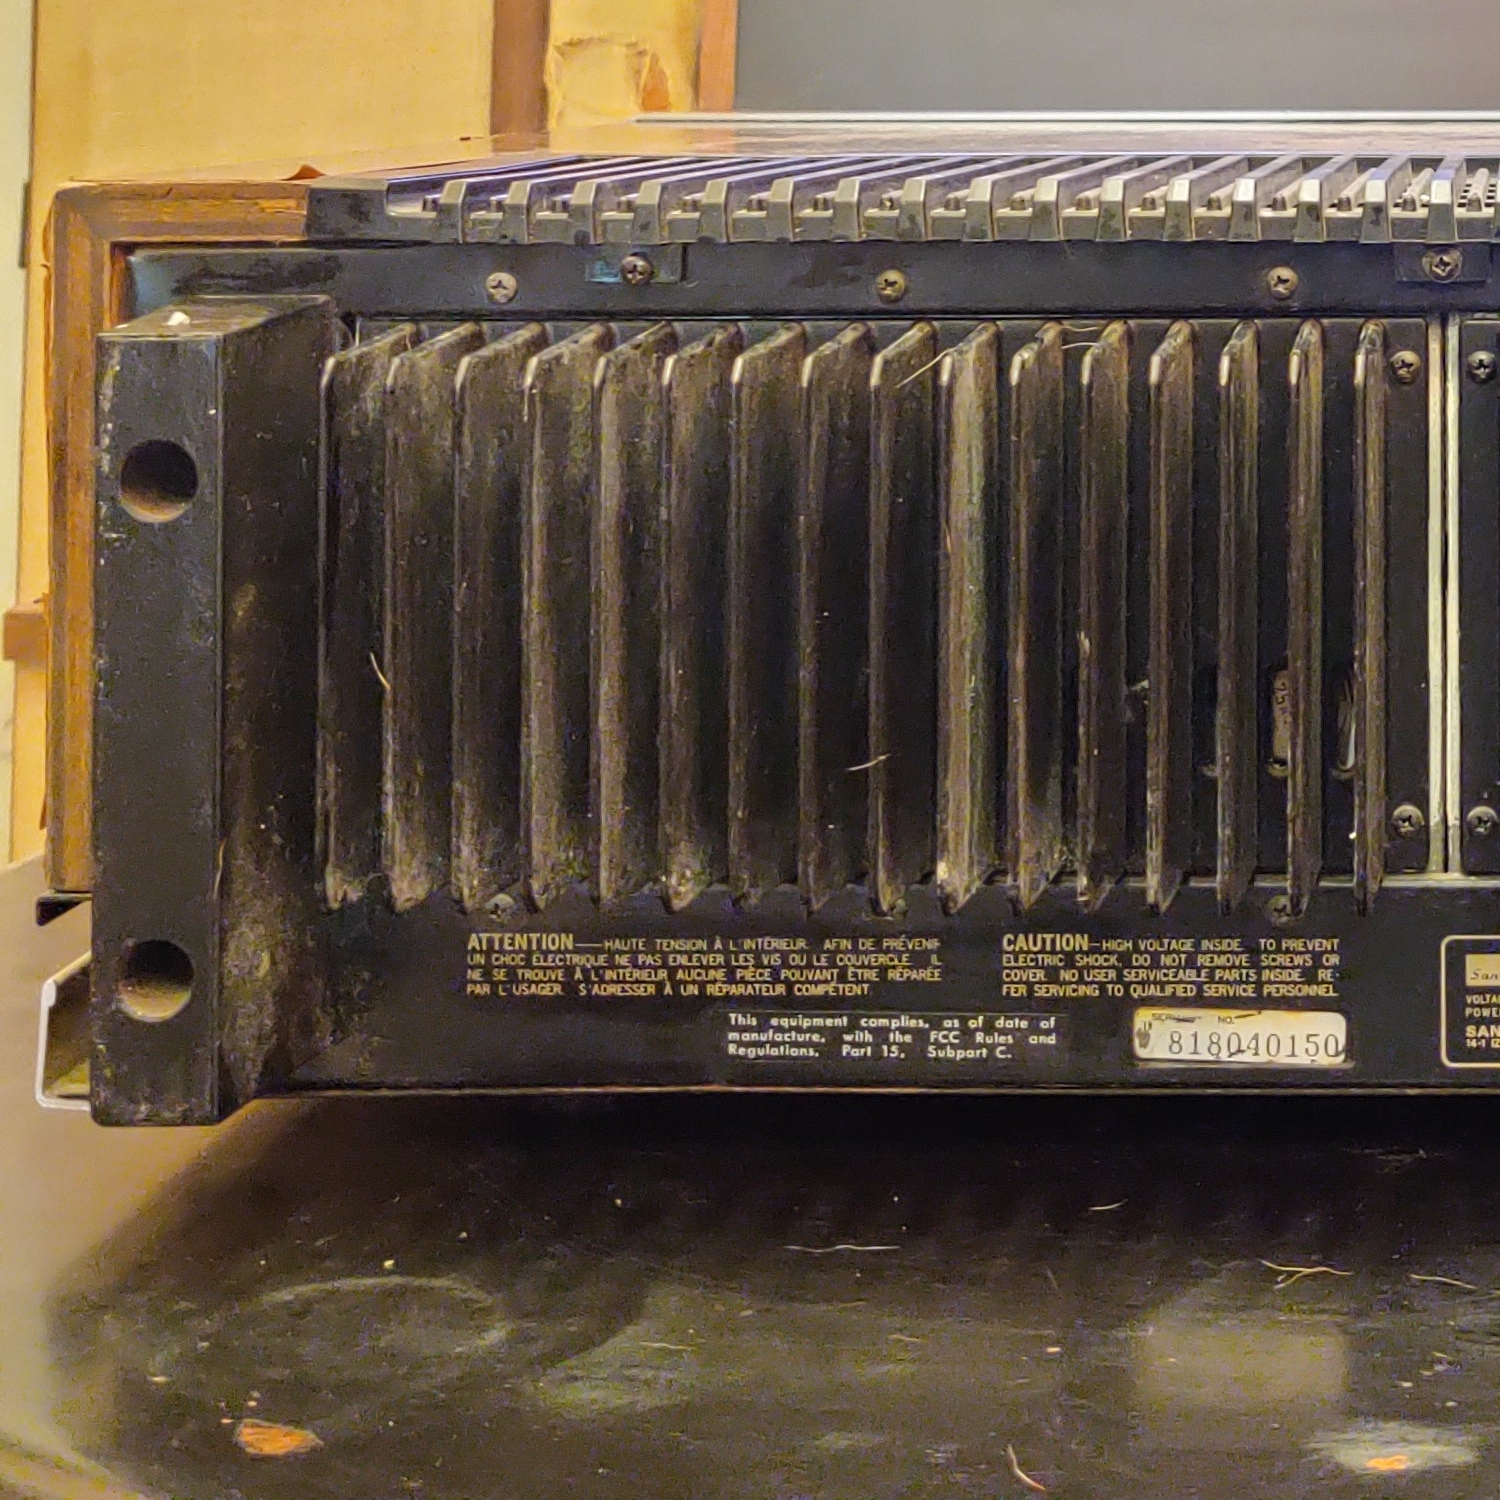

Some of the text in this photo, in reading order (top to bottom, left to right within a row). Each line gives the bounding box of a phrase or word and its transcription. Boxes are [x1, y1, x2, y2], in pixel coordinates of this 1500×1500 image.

[729, 1013, 757, 1026] This
[770, 1014, 848, 1030] equipment
[943, 1019, 960, 1028] as
[968, 1016, 984, 1028] of
[995, 1016, 1030, 1029] date
[1040, 1017, 1056, 1029] of
[843, 1031, 873, 1043] with
[889, 1031, 912, 1043] the
[930, 1031, 960, 1044] FCC
[975, 1031, 1014, 1044] Rules
[1029, 1032, 1056, 1045] and
[1168, 1030, 1341, 1059] 818040150
[842, 1046, 872, 1058] Part
[927, 1046, 988, 1061] Subpart
